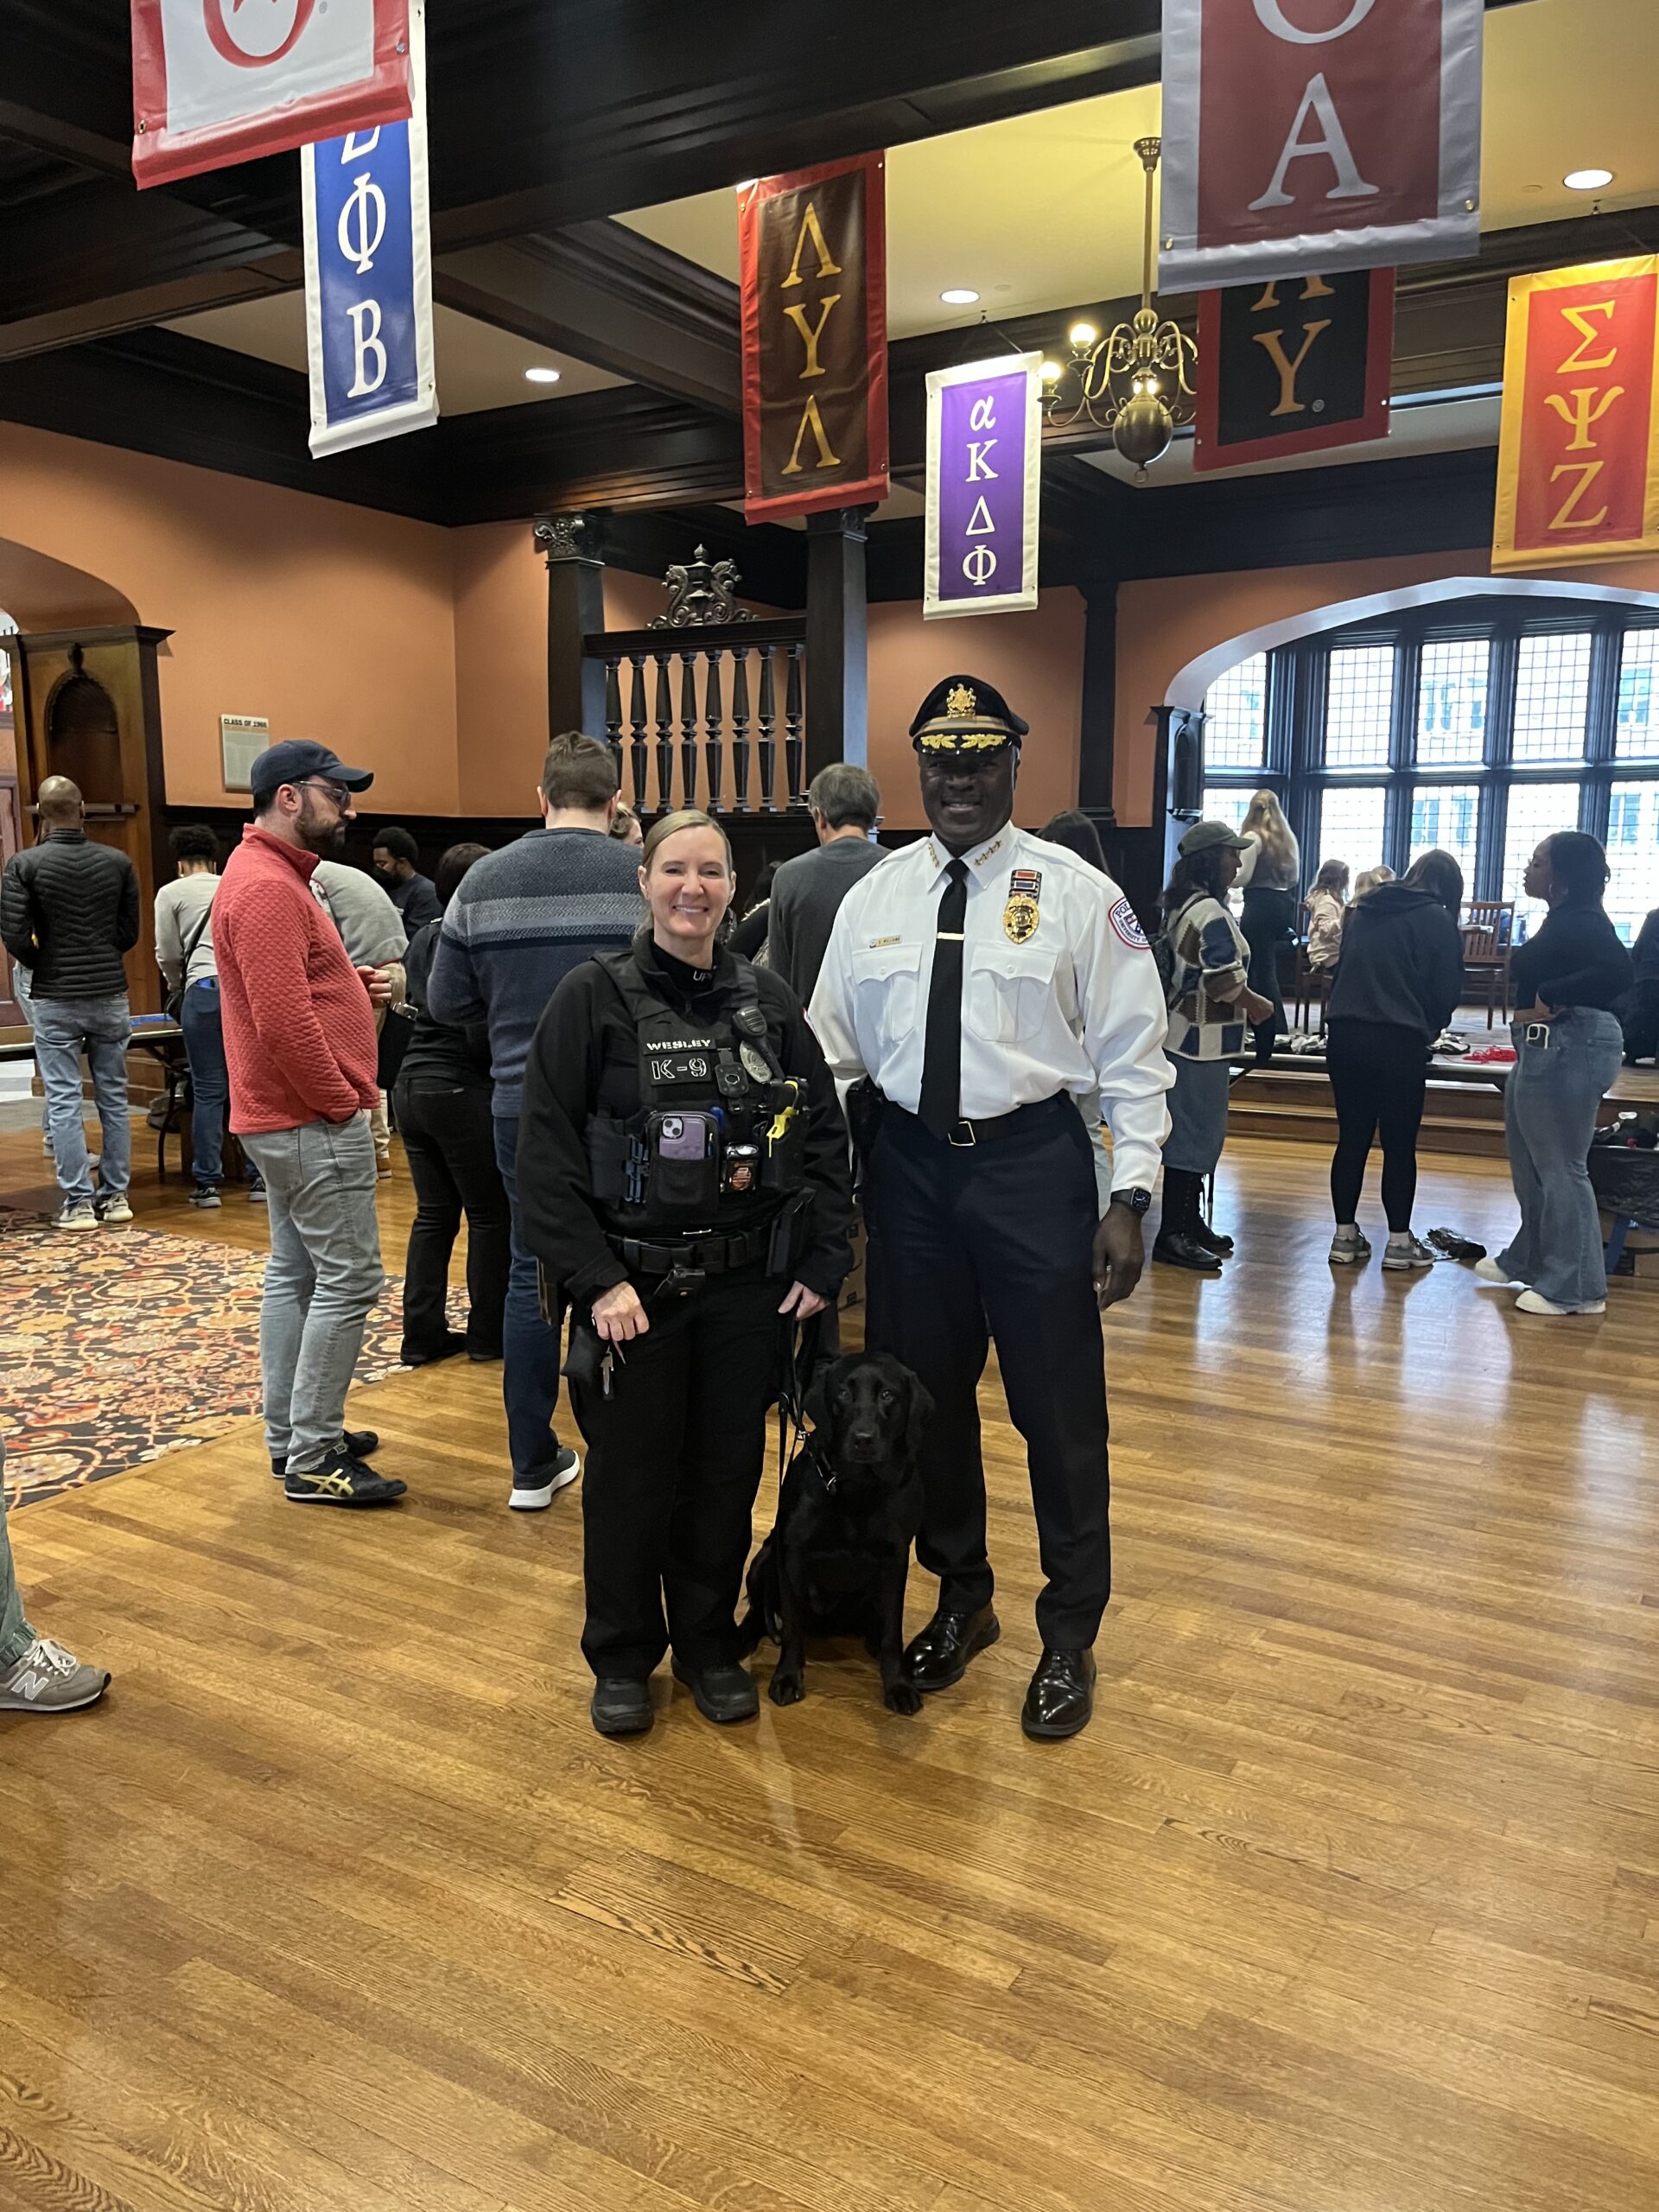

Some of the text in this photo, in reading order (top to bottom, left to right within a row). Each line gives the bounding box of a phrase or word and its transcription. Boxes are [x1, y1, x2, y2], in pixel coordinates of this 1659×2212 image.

[646, 1039, 710, 1051] WESLEY
[652, 1058, 708, 1080] K-9
[11, 1669, 49, 1701] N
